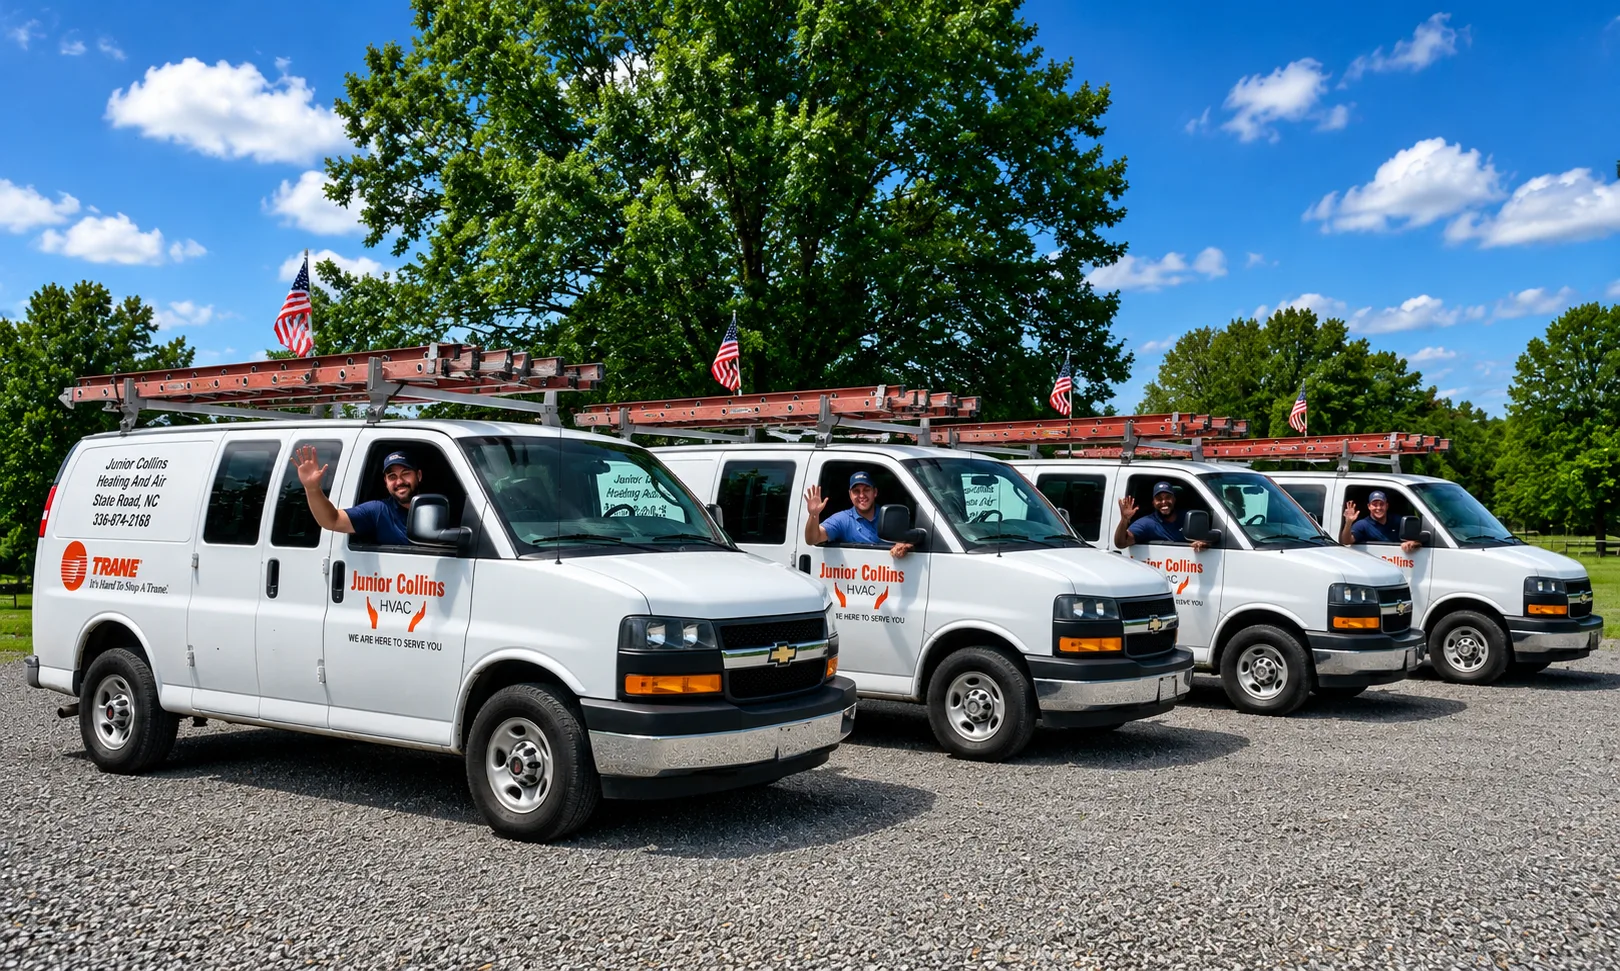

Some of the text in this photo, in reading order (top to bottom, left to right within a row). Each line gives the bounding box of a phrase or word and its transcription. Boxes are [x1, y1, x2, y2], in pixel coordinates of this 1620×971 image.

[105, 457, 169, 470] Junior Collins
[96, 474, 167, 490] Heating And Air
[92, 493, 160, 509] State Road, NC
[92, 512, 151, 527] 336-874-2168
[1165, 558, 1204, 573] Collins
[1381, 555, 1415, 568] llins
[820, 562, 905, 583] Junior Collins
[99, 579, 117, 590] Hard
[116, 580, 124, 590] To
[140, 582, 146, 592] A
[350, 570, 445, 597] Junior Collins
[846, 584, 876, 596] HVAC
[380, 599, 412, 614] HVAC
[843, 613, 860, 621] HERE
[861, 614, 870, 622] TO
[871, 615, 890, 623] SERVE
[891, 616, 905, 624] YOU
[348, 633, 442, 651] WE ARE HERE TO SERVE YOU
